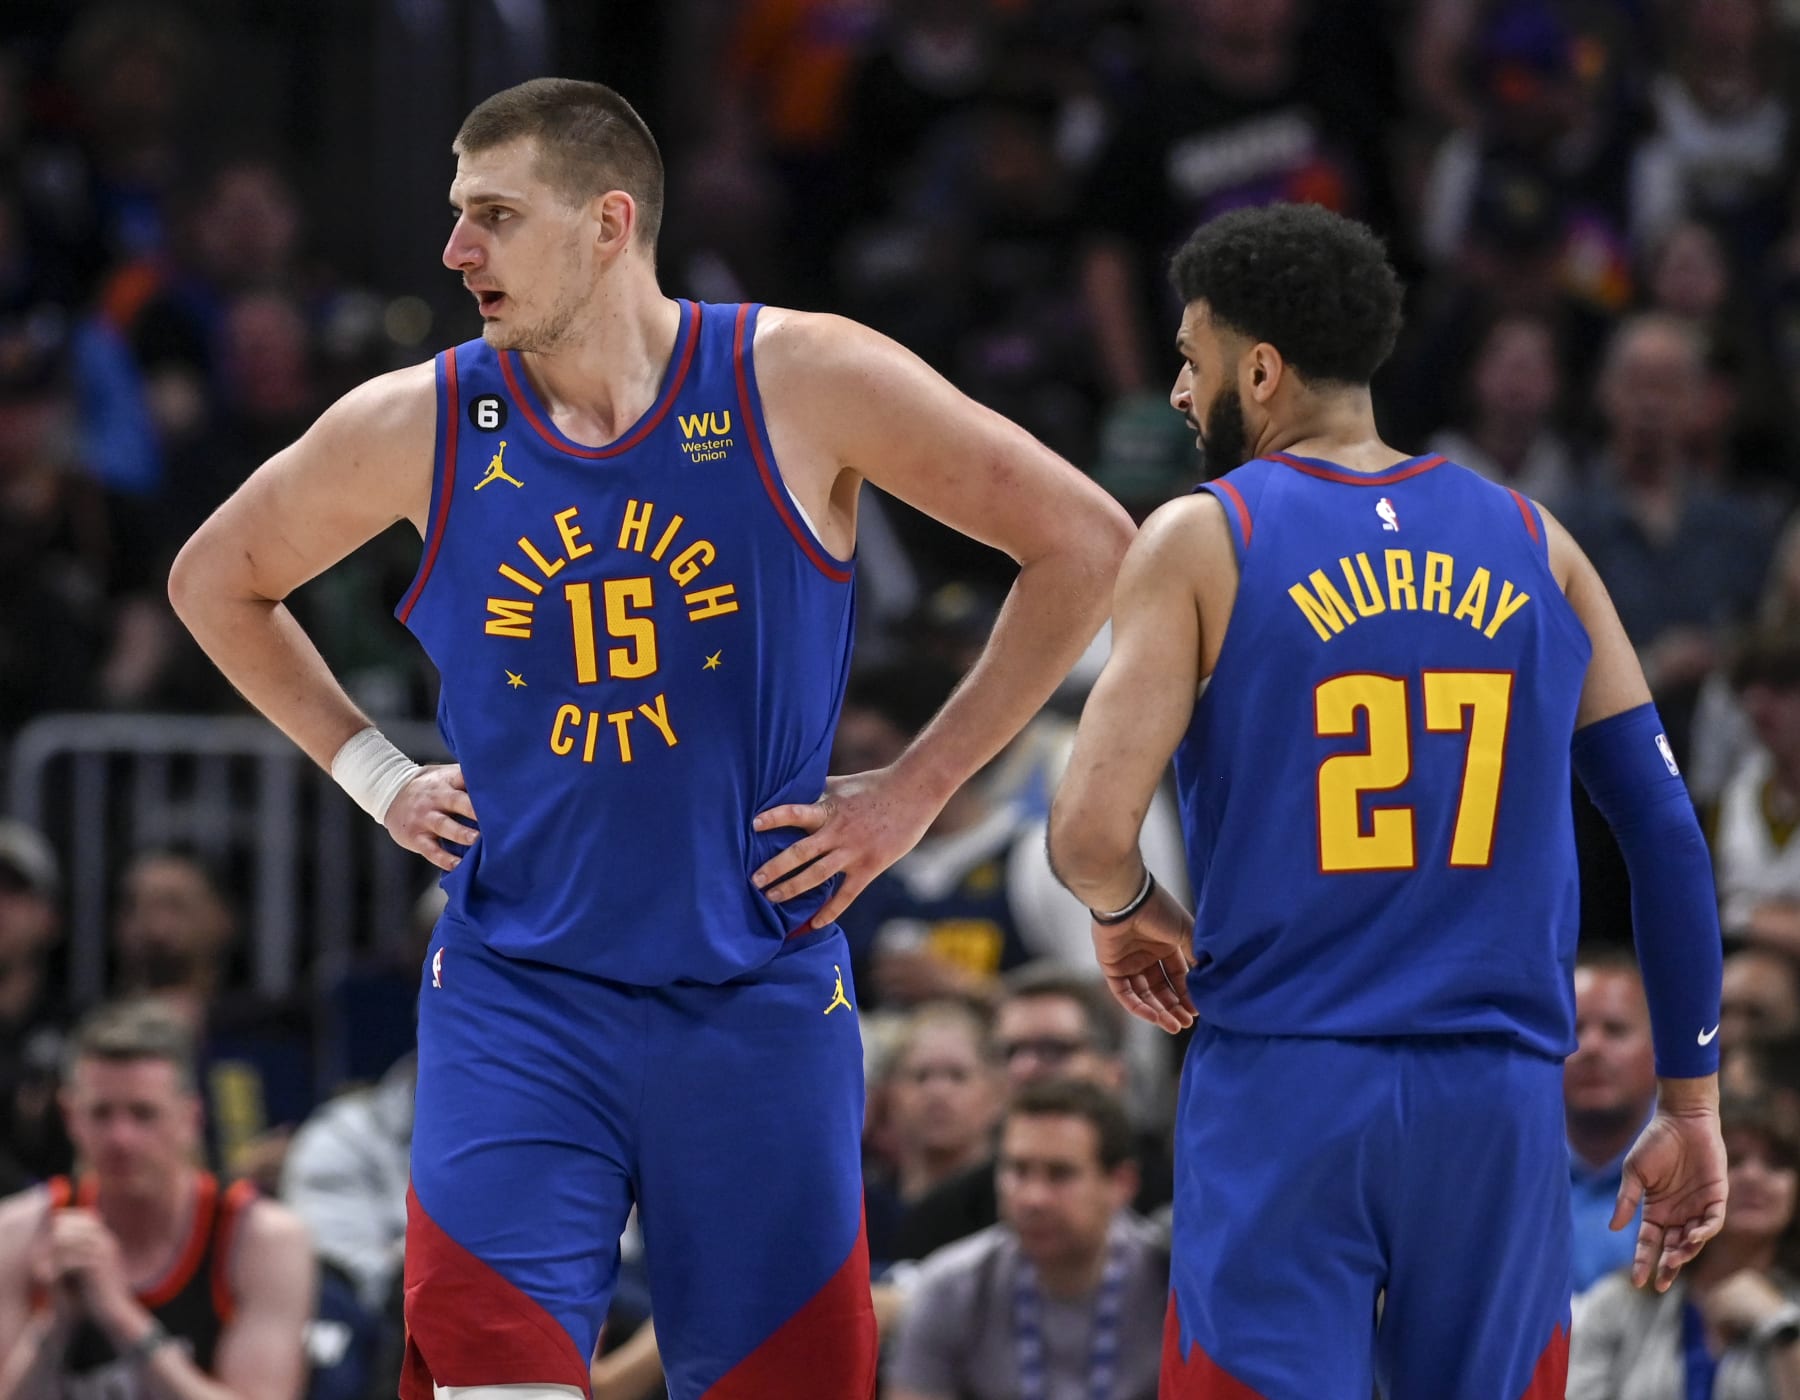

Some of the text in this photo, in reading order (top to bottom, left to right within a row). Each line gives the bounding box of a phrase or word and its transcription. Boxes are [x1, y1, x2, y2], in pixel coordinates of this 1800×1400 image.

[477, 399, 500, 429] 6
[678, 410, 731, 439] WU
[681, 438, 734, 453] Western
[691, 450, 727, 463] Union
[484, 498, 740, 640] MILE HIGH
[1287, 549, 1531, 643] MURRAY
[563, 575, 660, 685] 15
[549, 692, 680, 764] CITY
[1313, 669, 1515, 873] 27
